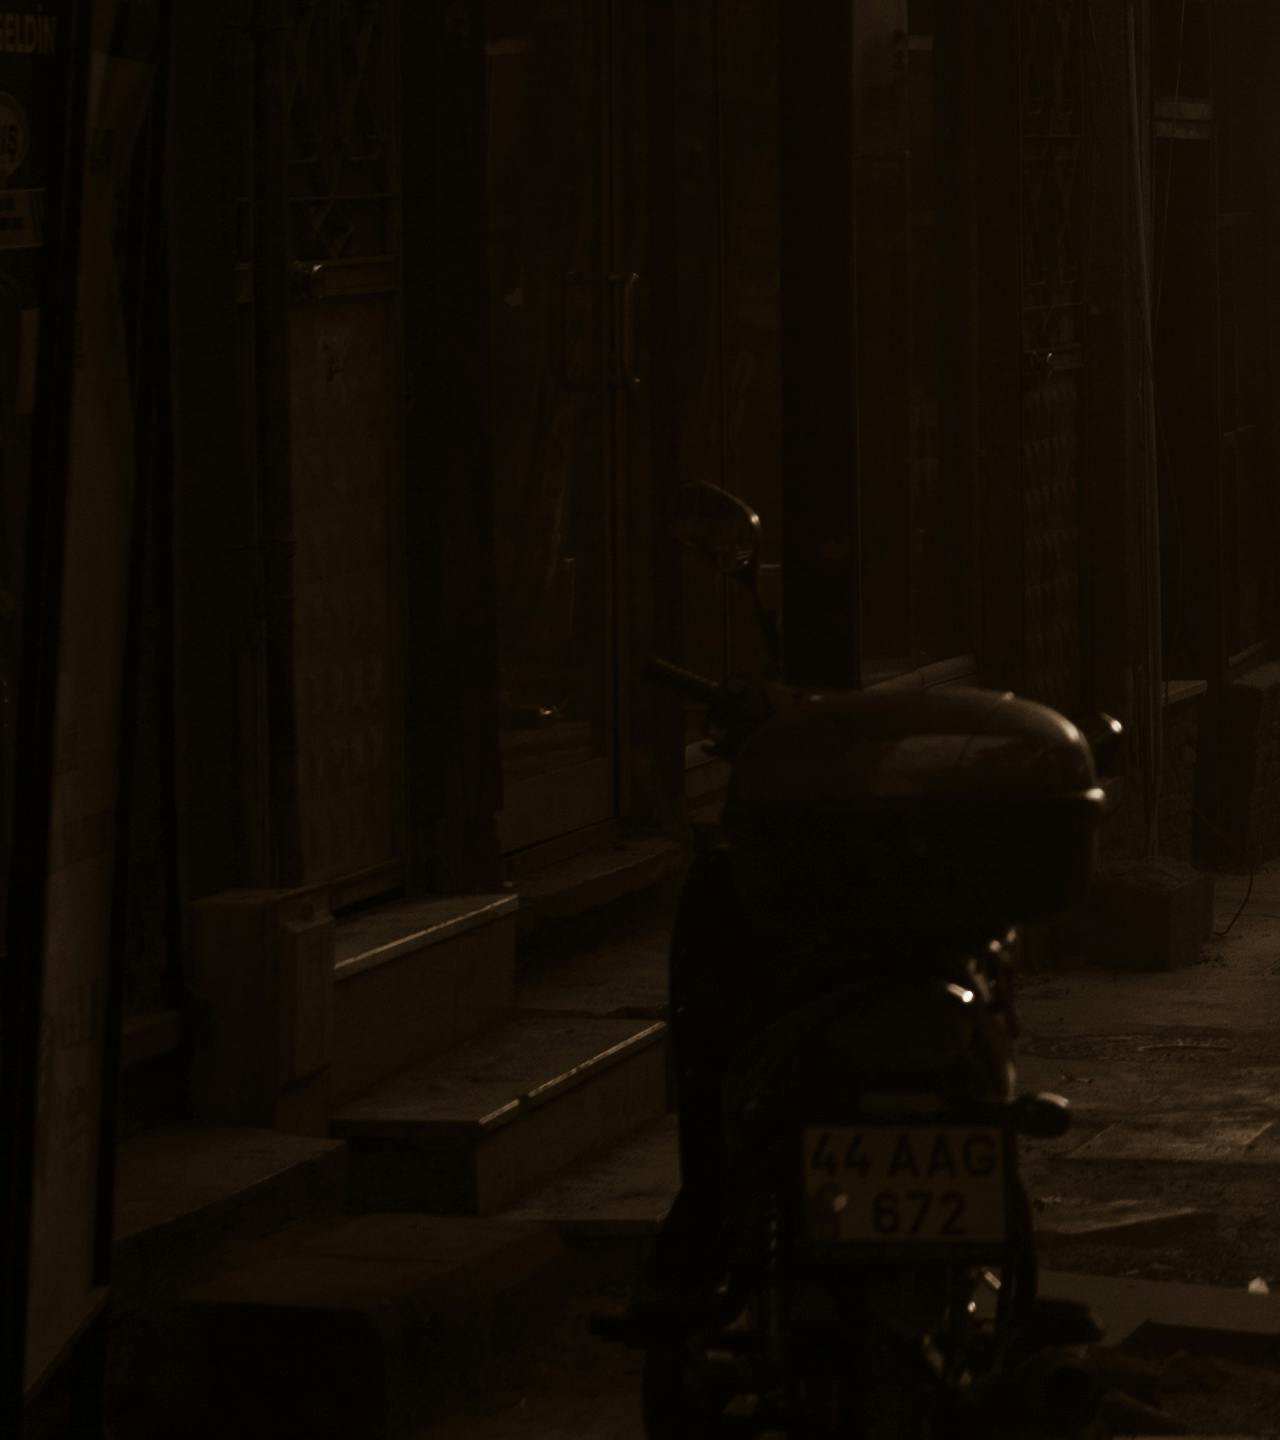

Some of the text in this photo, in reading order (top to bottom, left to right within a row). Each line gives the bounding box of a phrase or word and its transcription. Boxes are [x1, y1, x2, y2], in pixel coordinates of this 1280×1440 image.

[811, 1133, 997, 1177] 44 AAG
[873, 1189, 968, 1236] 672
